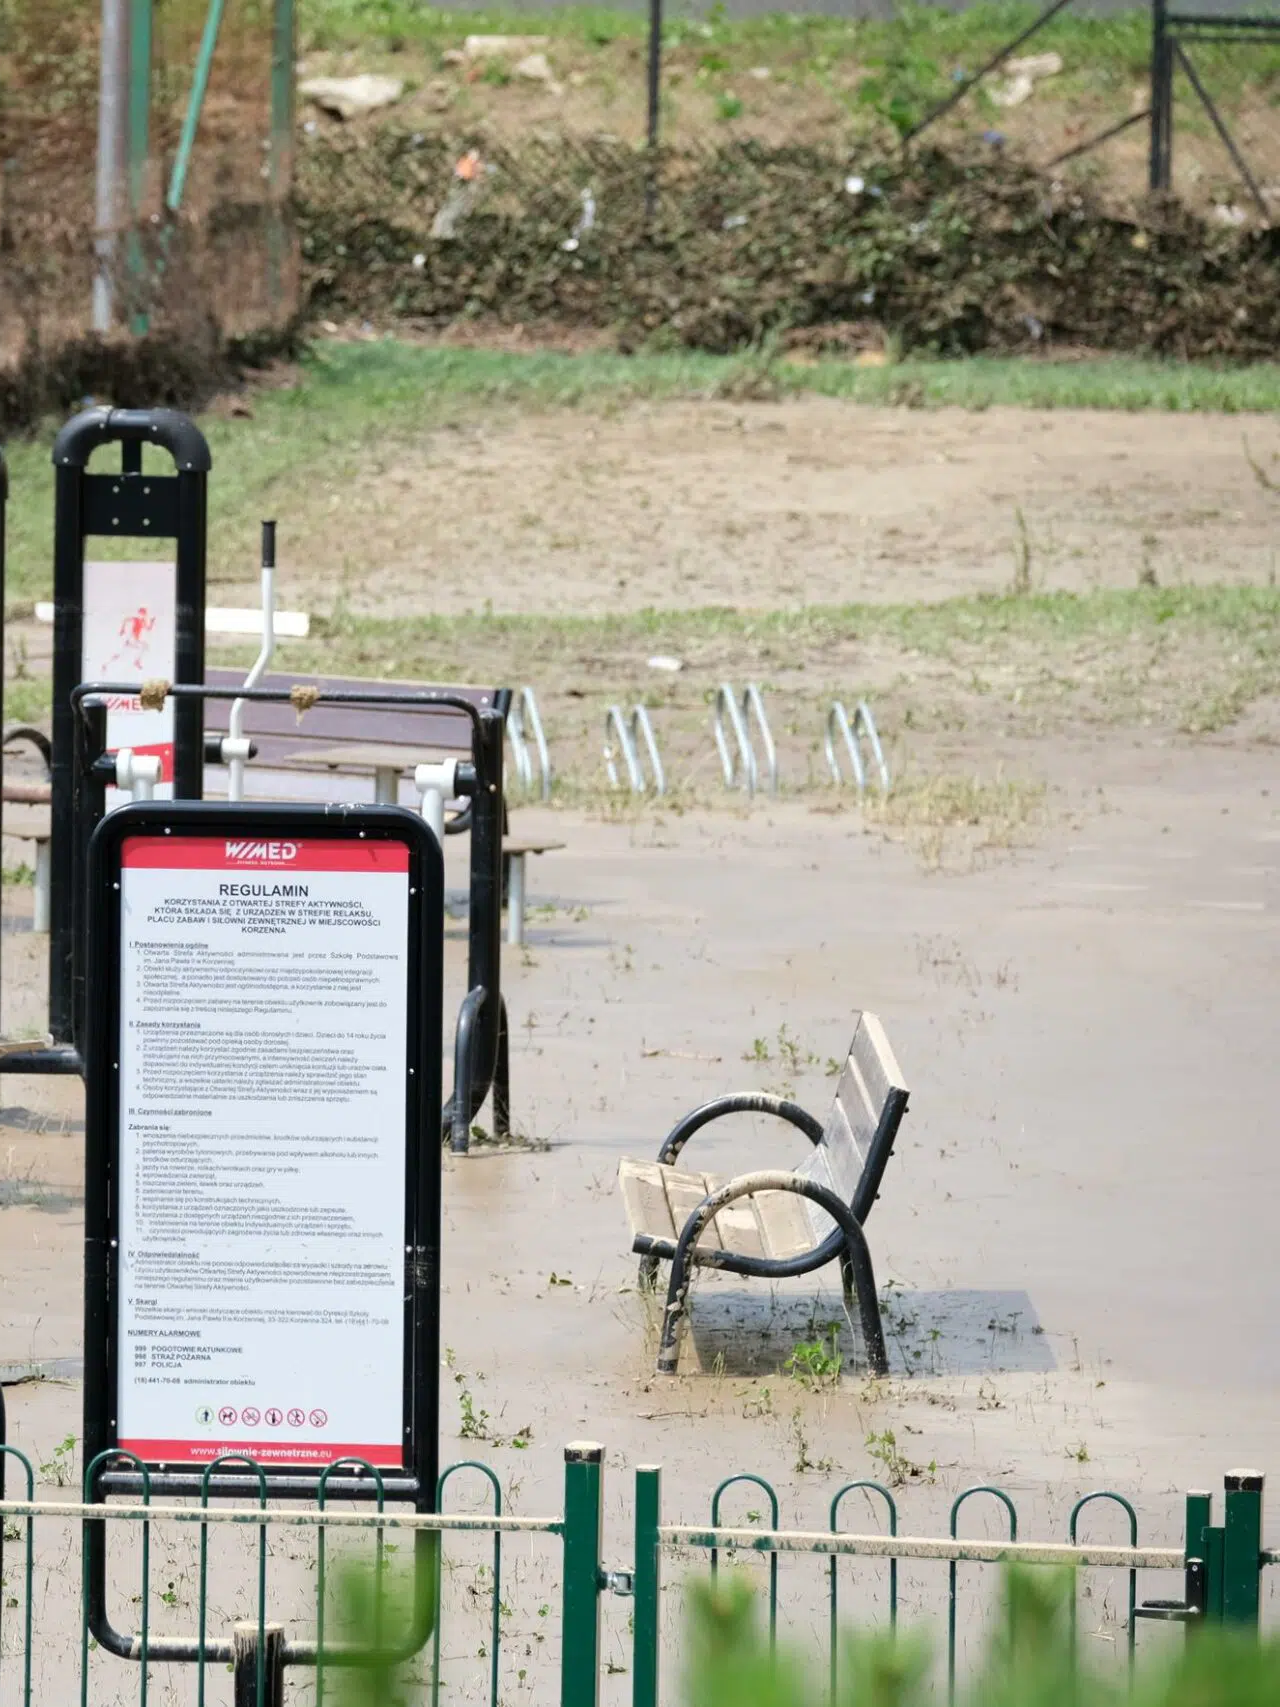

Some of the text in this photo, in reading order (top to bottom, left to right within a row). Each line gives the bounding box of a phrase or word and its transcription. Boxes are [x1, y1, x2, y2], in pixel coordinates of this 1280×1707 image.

[219, 884, 309, 897] REGULAMIN
[308, 899, 364, 909] AKTYWNOŚCI,
[154, 906, 182, 914] KTÓRA
[333, 909, 374, 918] RELAKSU,
[248, 917, 306, 925] ZEWNĘTRZNEJ
[318, 917, 381, 925] MIEJSCOWOŚCI
[136, 1298, 158, 1306] Skargi
[158, 1329, 201, 1337] ALARMOWE
[176, 1353, 211, 1361] POŻARNA
[190, 1446, 332, 1458] www.silownie-zewnetrzne.eu
